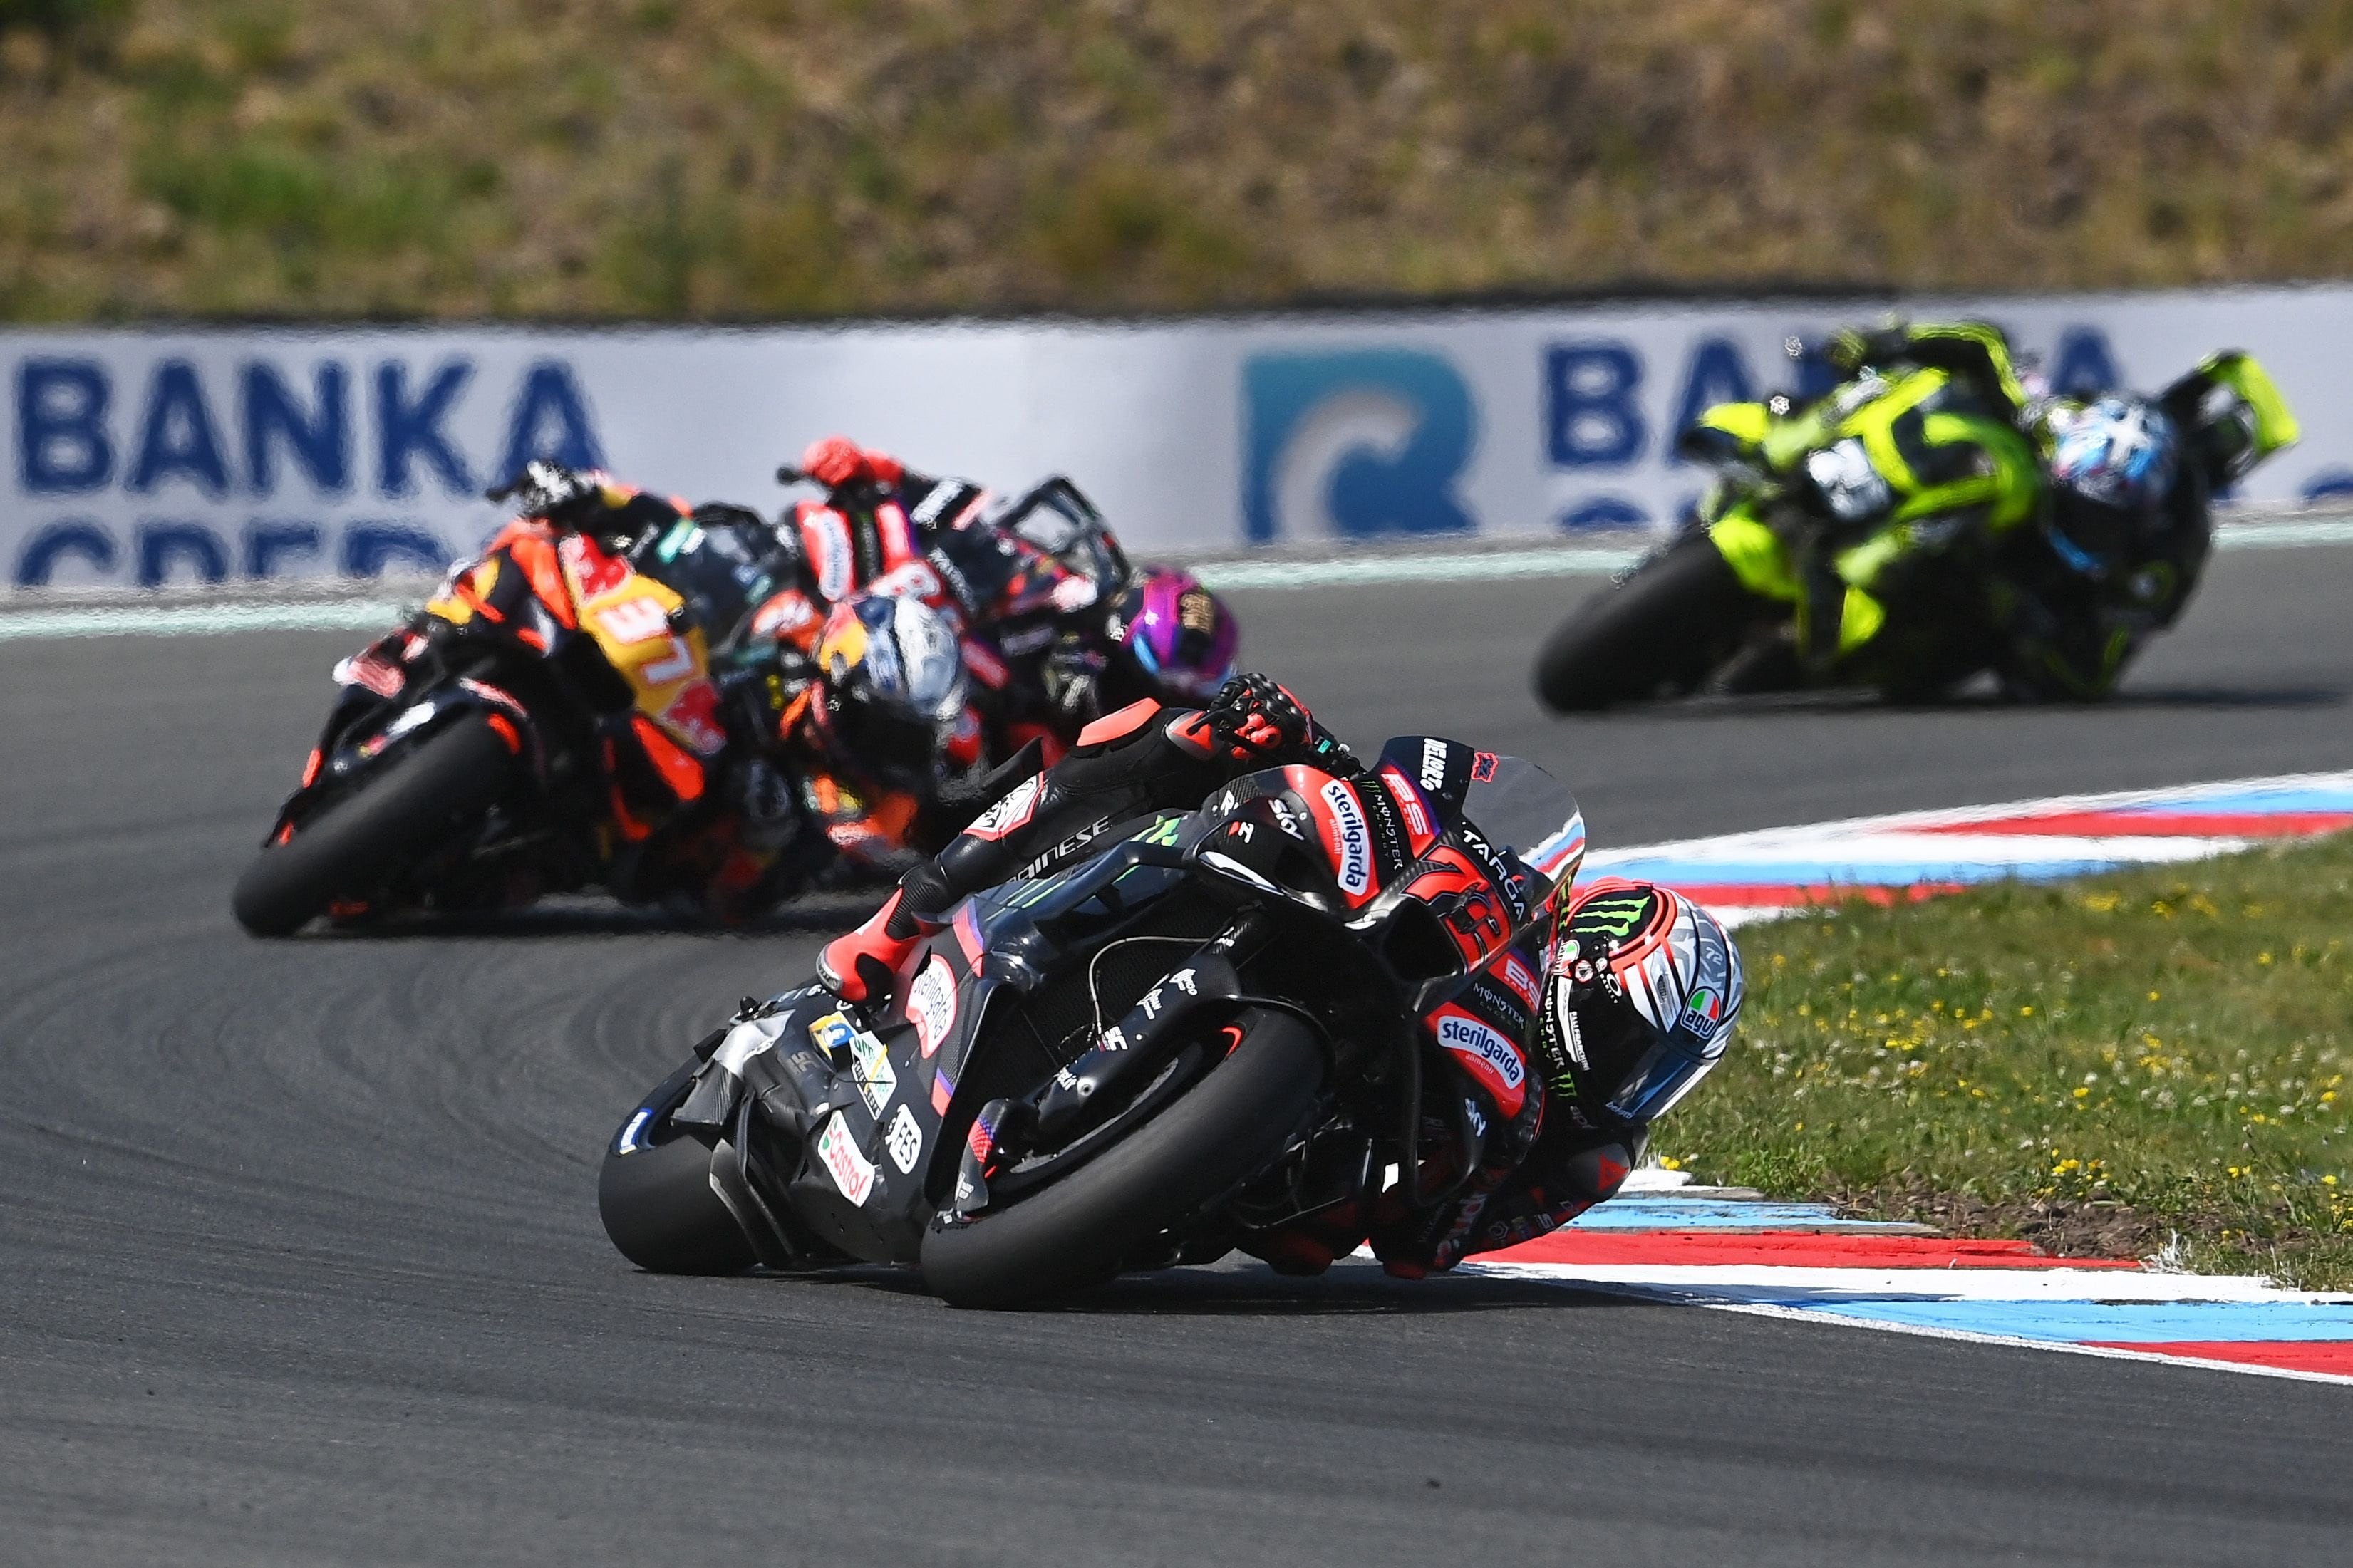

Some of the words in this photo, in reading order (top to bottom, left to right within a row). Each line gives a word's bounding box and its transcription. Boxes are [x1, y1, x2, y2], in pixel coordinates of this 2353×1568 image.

[16, 356, 610, 495] BANKA
[1374, 794, 1404, 870] MONSTER
[1380, 773, 1429, 836] BS
[1328, 785, 1367, 888] sterilgarda
[1329, 818, 1343, 855] alimenti
[1463, 829, 1526, 922] TARGA
[1705, 947, 1724, 966] 72
[1472, 982, 1525, 1030] MONSTER
[1685, 1009, 1714, 1034] agv
[1442, 1020, 1520, 1081] sterilgarda
[1465, 1053, 1495, 1076] alimenti
[829, 1131, 869, 1202] Castrol
